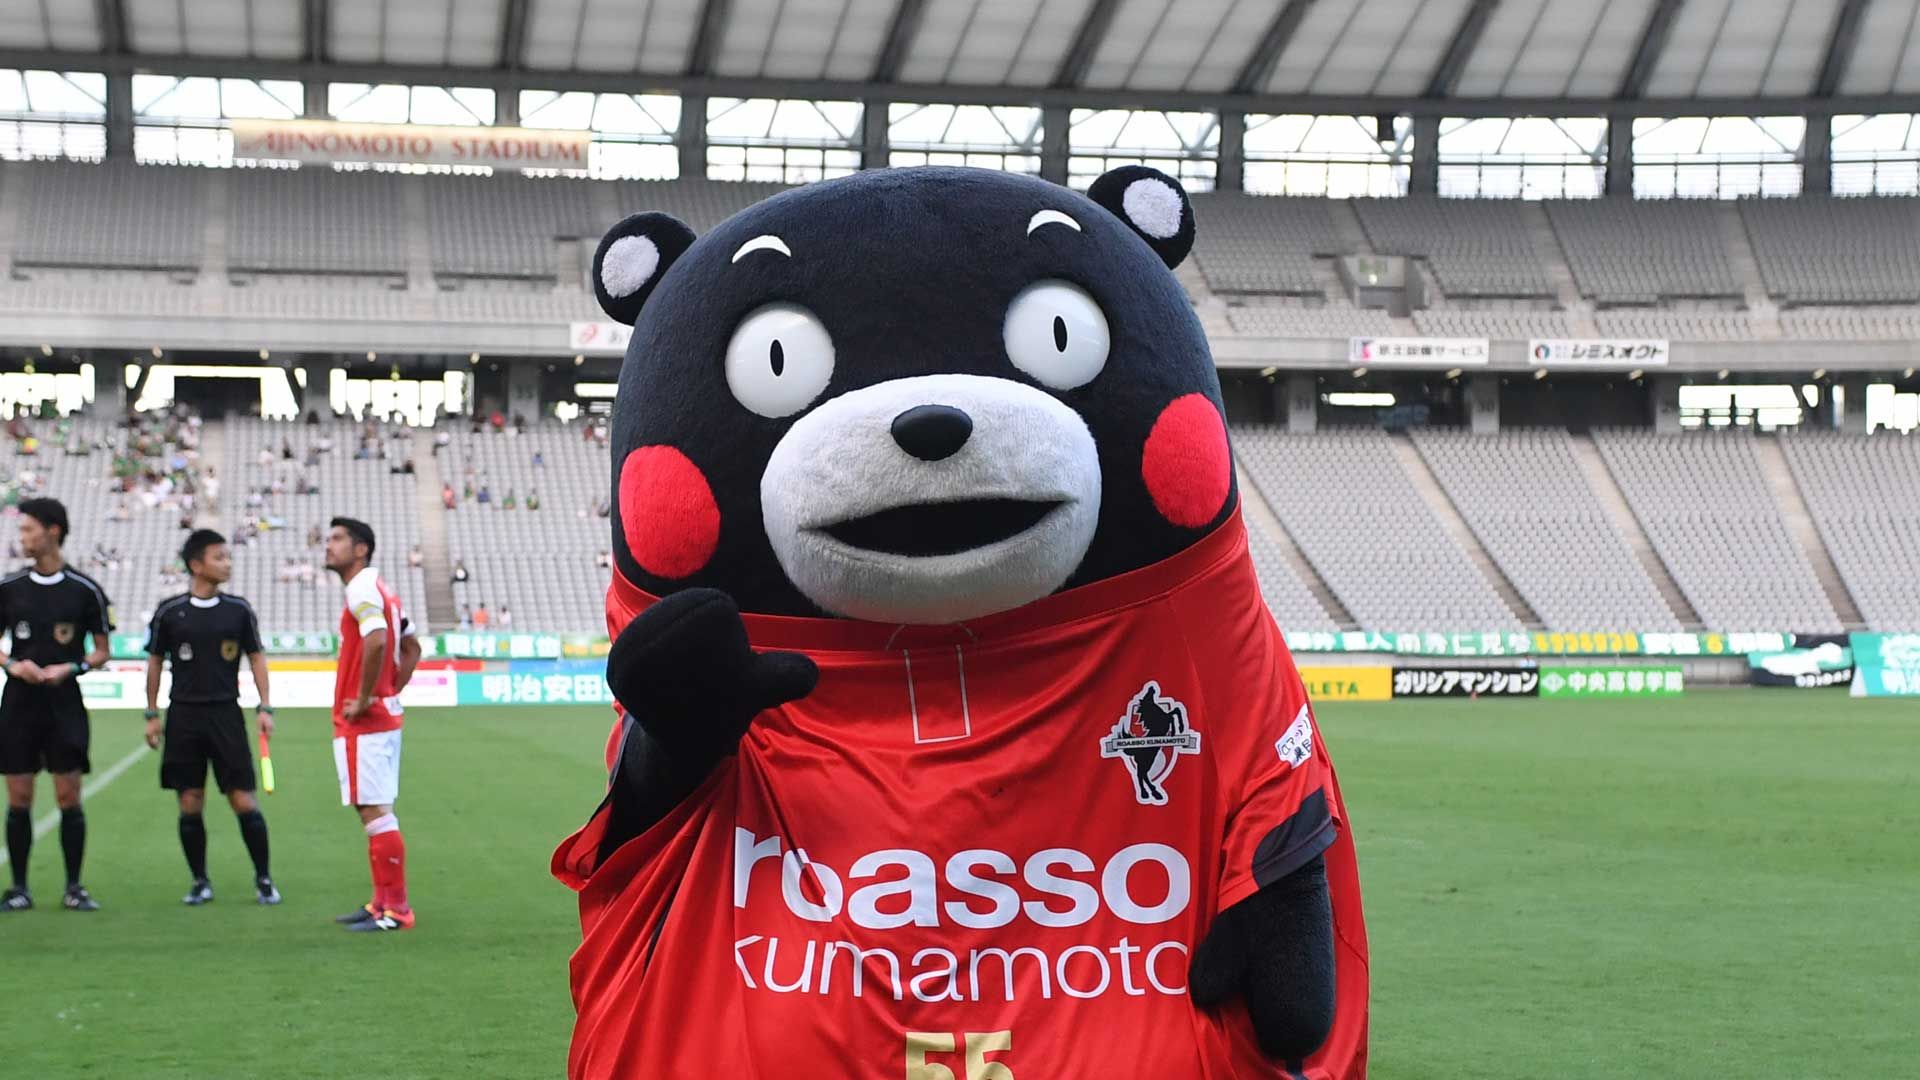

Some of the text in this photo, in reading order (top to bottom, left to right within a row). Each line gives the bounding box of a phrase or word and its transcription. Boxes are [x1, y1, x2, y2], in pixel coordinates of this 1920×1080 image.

[452, 139, 581, 163] STADIUM
[1394, 669, 1538, 694] ガリシアマンション
[1116, 737, 1186, 747] ROASSO KUMAMOTO
[734, 826, 1191, 929] roasso
